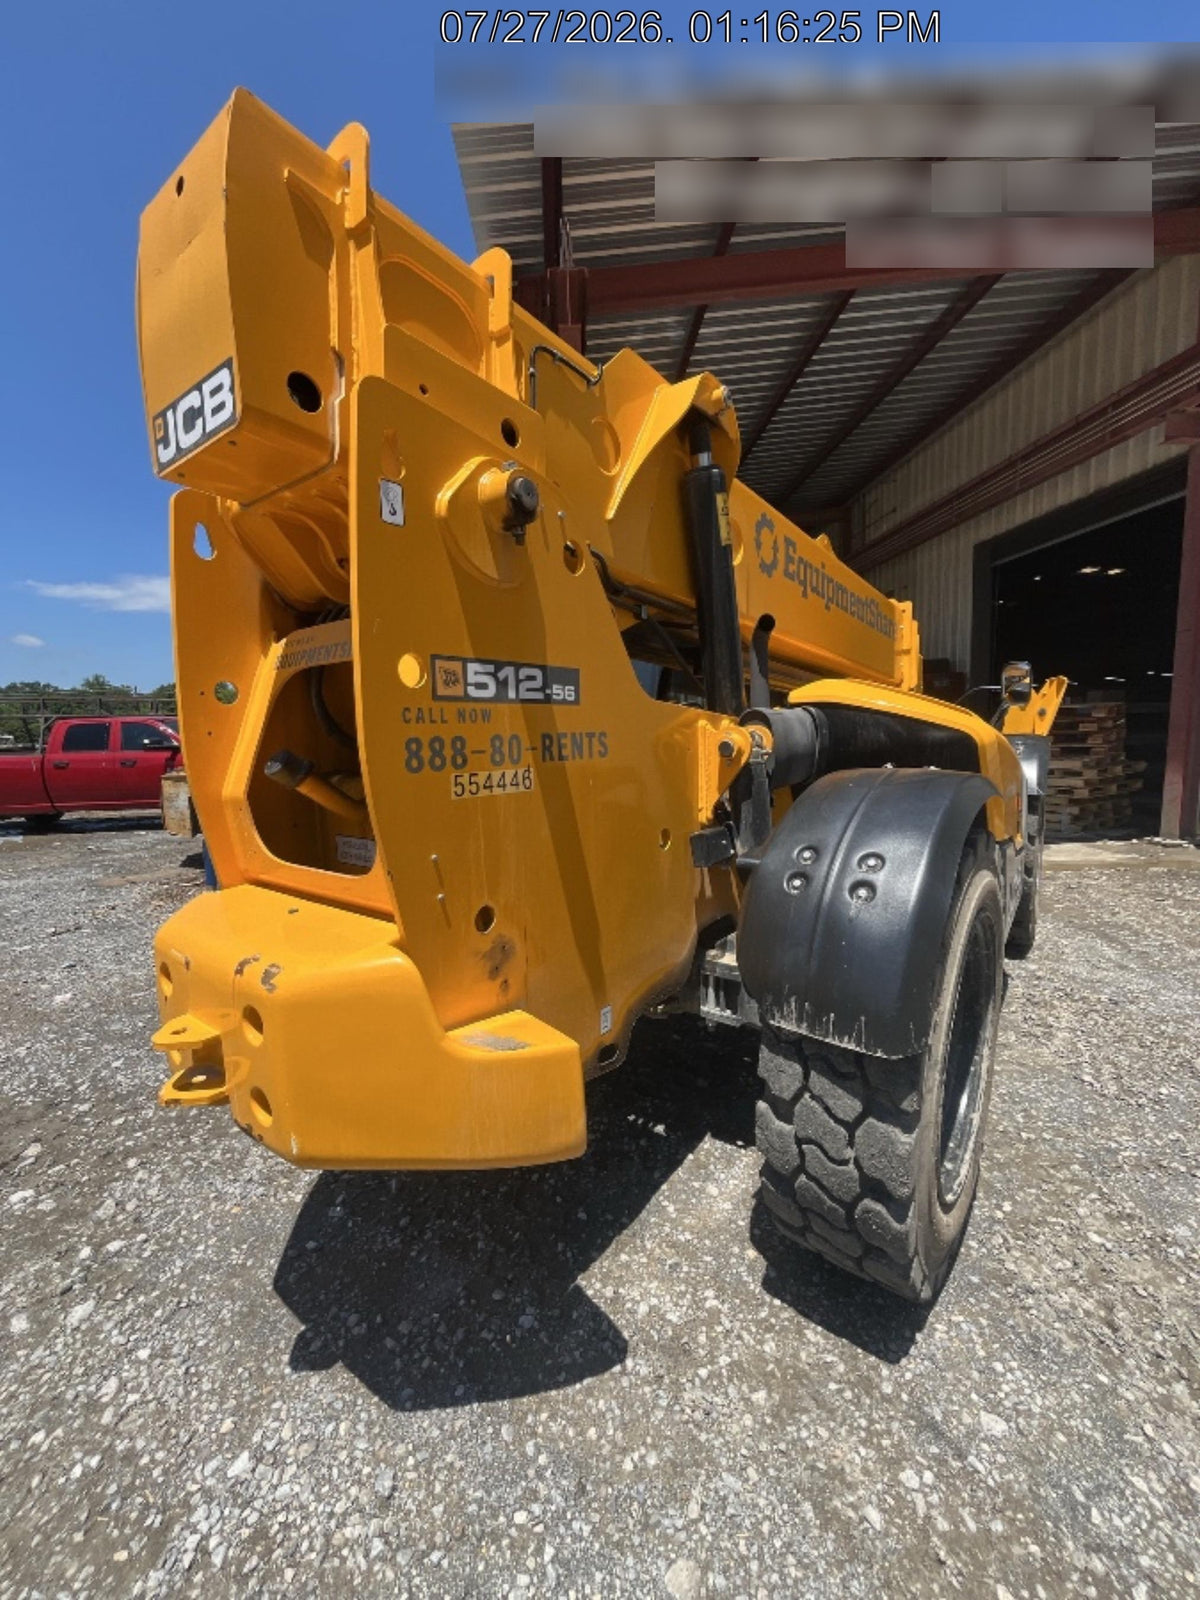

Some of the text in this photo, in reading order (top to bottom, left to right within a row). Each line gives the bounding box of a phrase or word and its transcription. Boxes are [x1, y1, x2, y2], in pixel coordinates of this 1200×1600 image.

[157, 367, 234, 463] JCB
[466, 662, 575, 701] 512-56
[402, 707, 492, 724] CALL NOW
[404, 731, 609, 774] 888-80-RENTS
